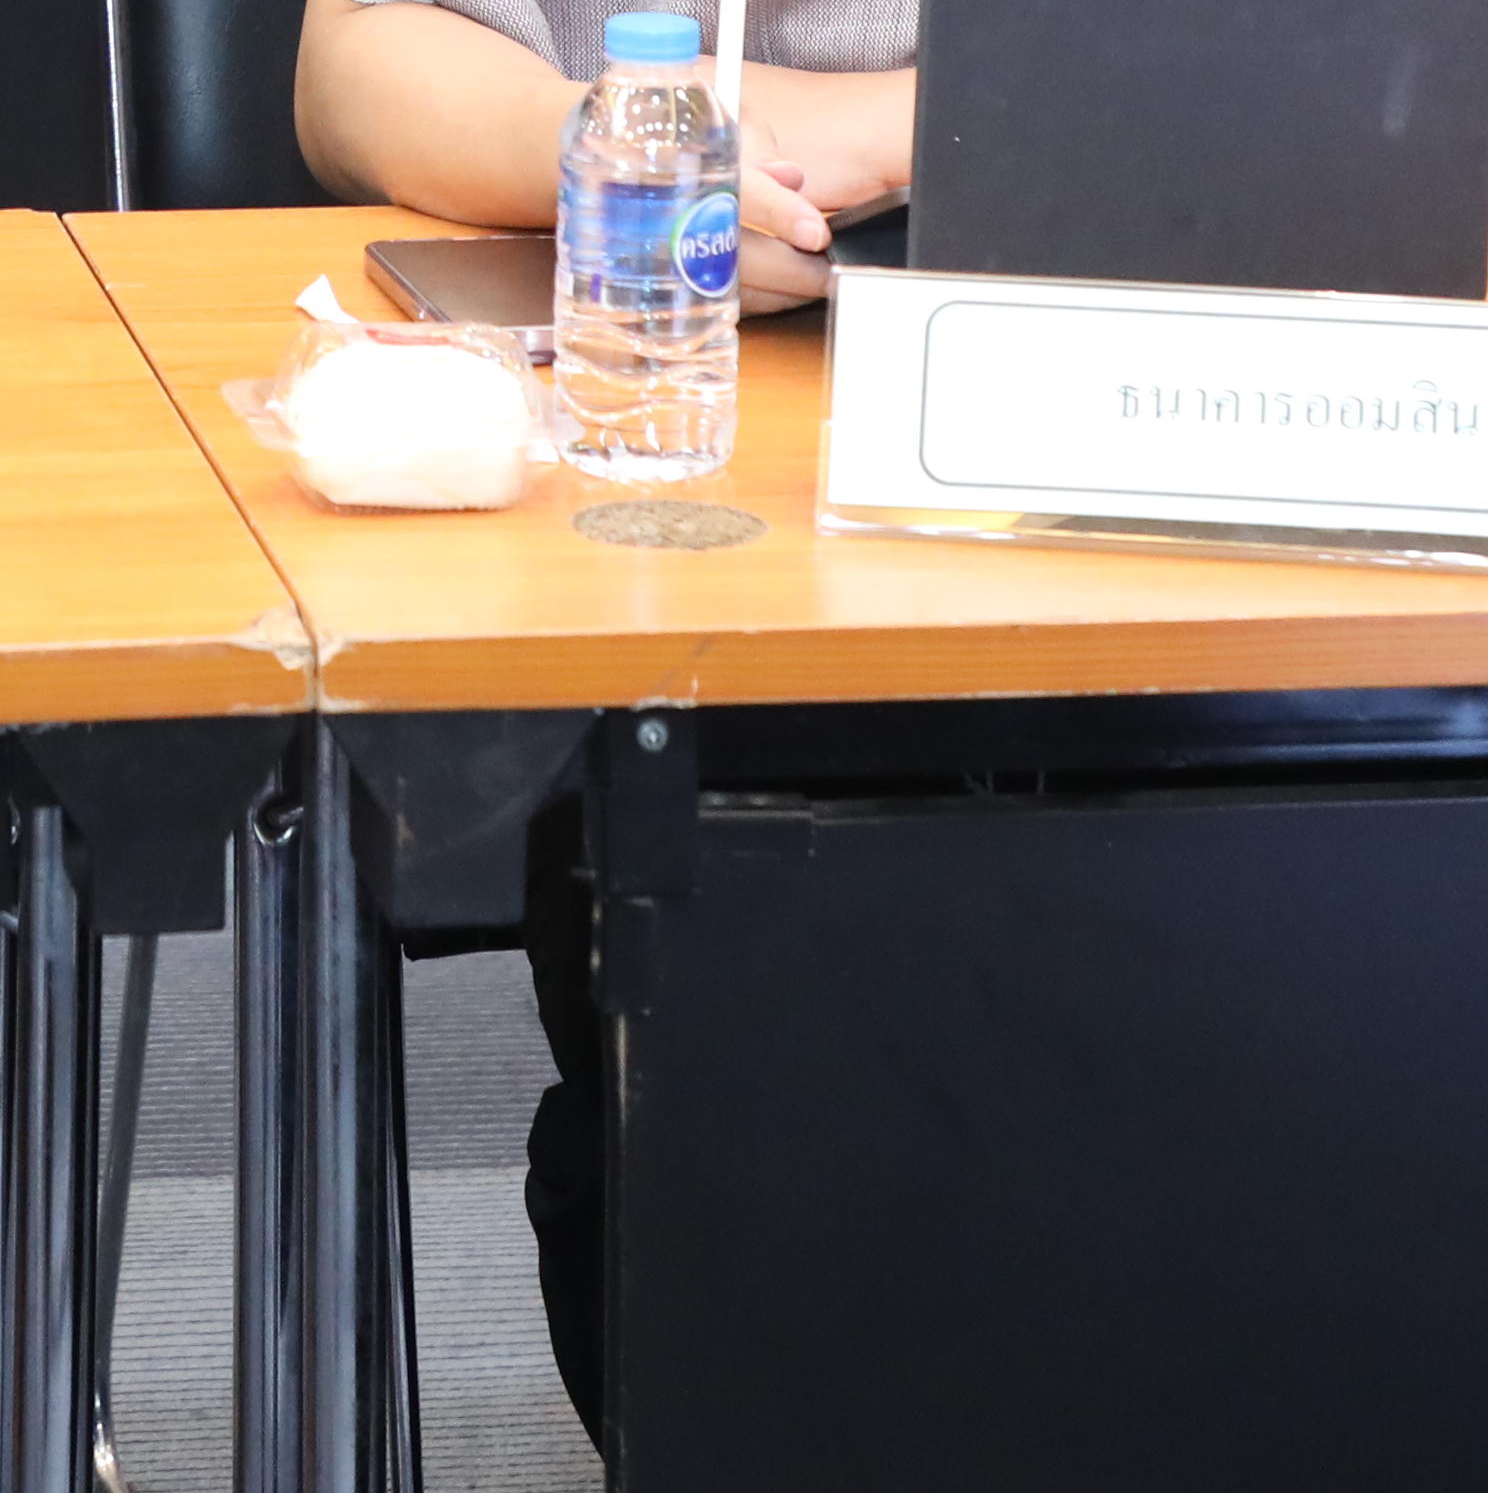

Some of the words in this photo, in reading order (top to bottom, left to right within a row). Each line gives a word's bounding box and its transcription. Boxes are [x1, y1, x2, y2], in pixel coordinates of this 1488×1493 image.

[1117, 380, 1478, 435] ธนาคารออมสิน
